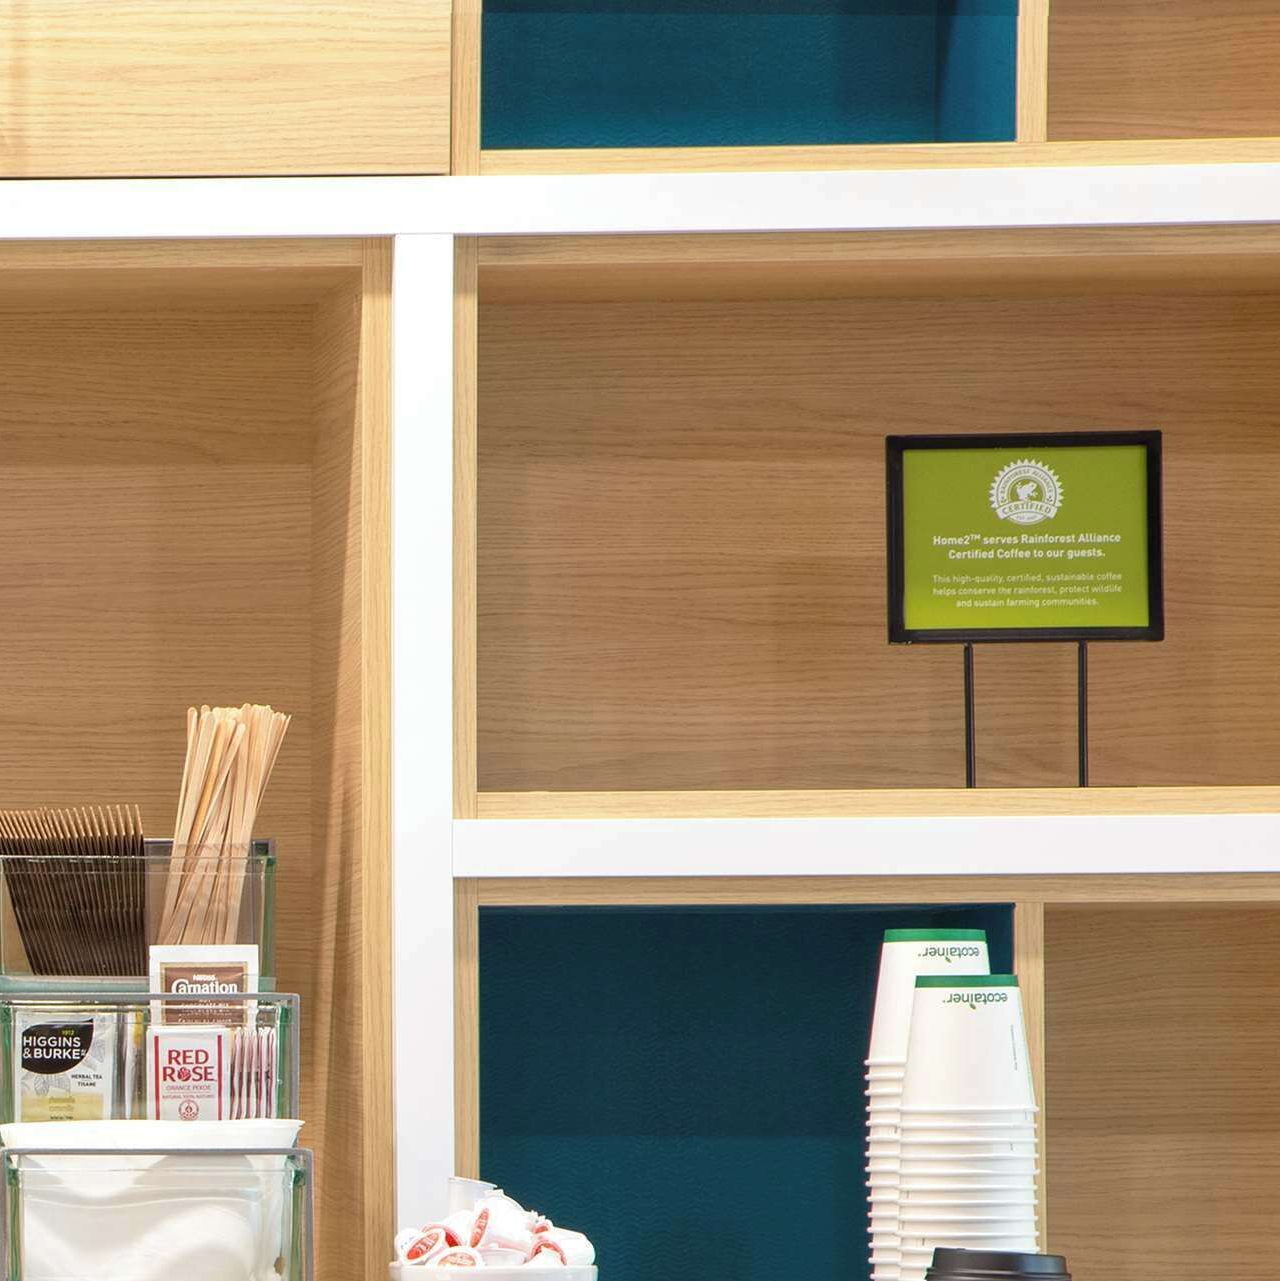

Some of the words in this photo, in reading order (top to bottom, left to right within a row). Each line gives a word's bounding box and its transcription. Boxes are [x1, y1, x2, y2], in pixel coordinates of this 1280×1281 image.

[1002, 503, 1052, 514] CERTIFIED
[983, 536, 1018, 545] serves
[1021, 534, 1075, 544] Rainforest
[1078, 533, 1121, 543] Alliance
[948, 549, 994, 560] Certified
[997, 549, 1031, 559] Coffee
[1033, 550, 1043, 558] to
[1046, 550, 1064, 558] our
[1067, 549, 1105, 560] guests.
[933, 575, 951, 584] This
[1046, 573, 1093, 582] sustainable
[1097, 573, 1122, 581] coffee
[933, 587, 956, 596] helps
[1060, 586, 1090, 594] protect
[1092, 585, 1122, 593] wildlife
[956, 599, 971, 608] and
[974, 599, 1005, 608] sustain
[1007, 598, 1039, 608] farming
[1042, 598, 1099, 607] communities.
[924, 947, 980, 960] ecotainer
[171, 978, 238, 994] Carnation
[947, 992, 1008, 1006] ecotainer
[23, 1036, 81, 1047] HIGGINS
[168, 1050, 210, 1065] RED
[163, 1066, 215, 1082] ROSE
